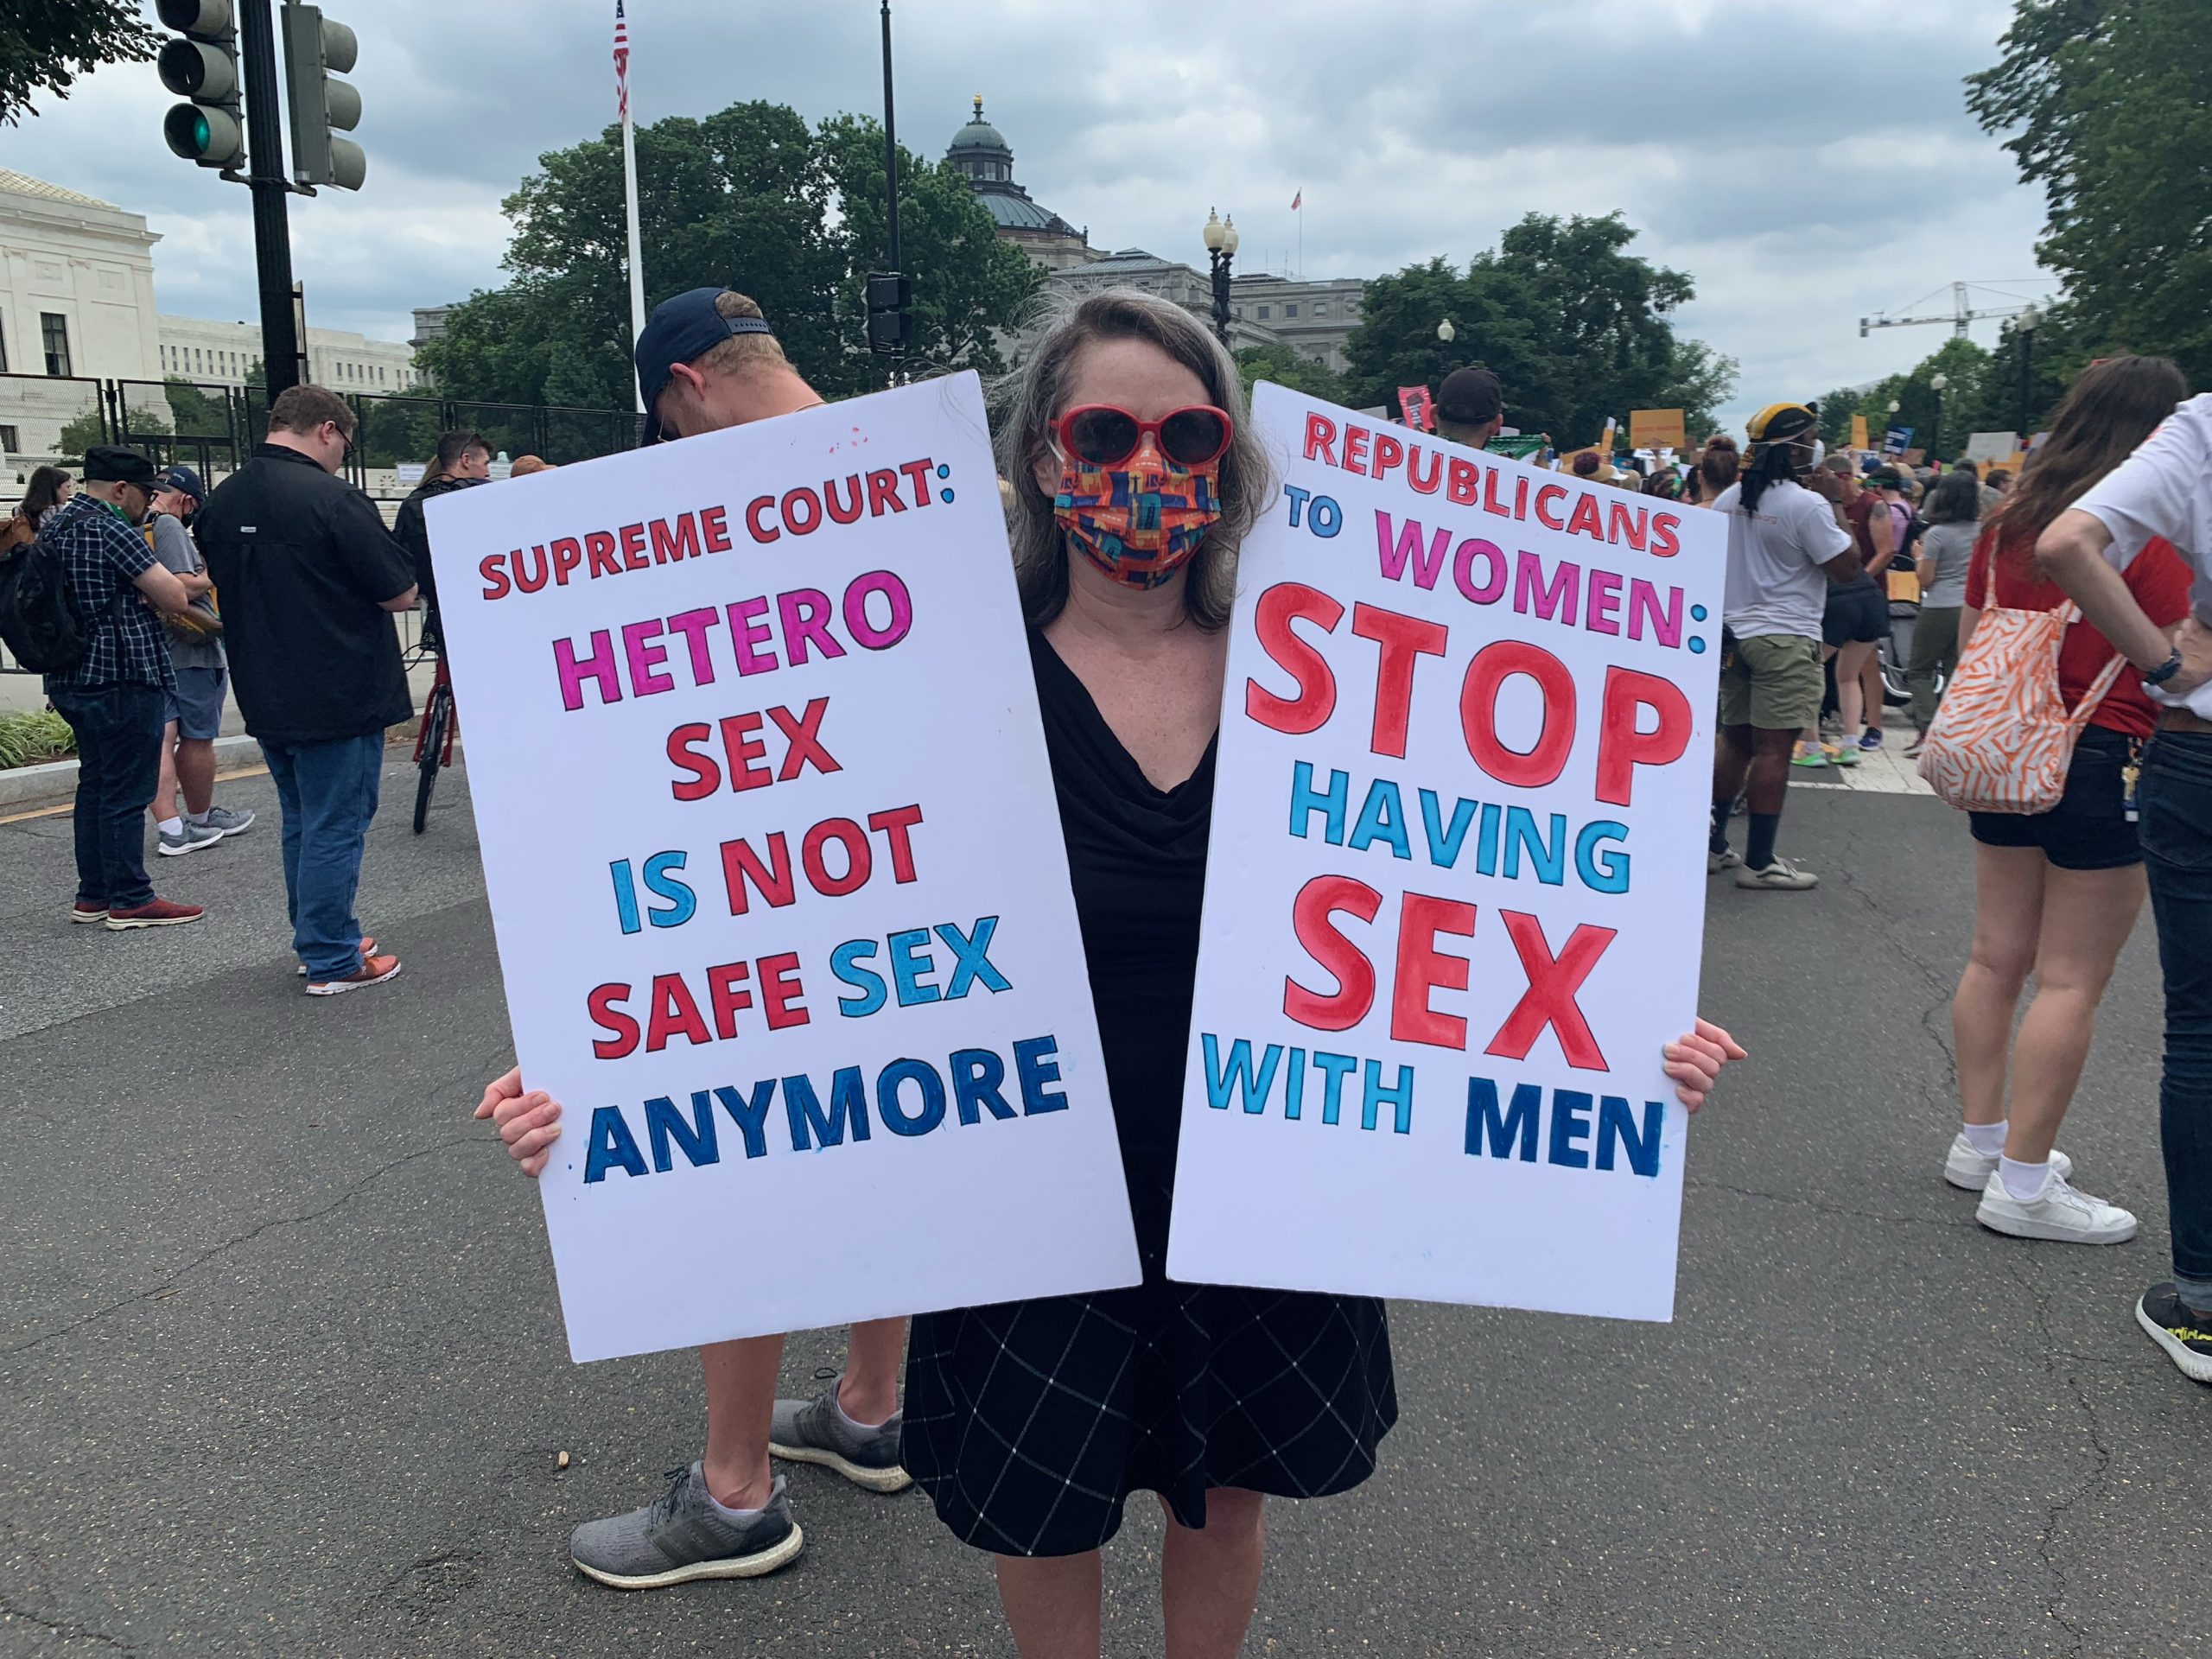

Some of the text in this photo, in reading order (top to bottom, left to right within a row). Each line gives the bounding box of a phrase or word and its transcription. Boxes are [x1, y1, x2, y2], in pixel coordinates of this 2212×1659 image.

[479, 457, 956, 601] SUPREME COURT:
[1303, 410, 1681, 558] REPUBLICANS
[552, 569, 912, 712] HETERO
[1284, 483, 1708, 655] TO WOMEN:
[666, 696, 843, 802] SEX
[1244, 582, 1693, 807] STOP
[609, 803, 924, 936] IS NOT
[1288, 760, 1631, 894] HAVING
[587, 915, 1014, 1060] SAFE SEX
[1282, 874, 1618, 1072] SEX
[583, 1034, 1070, 1185] ANYMORE
[1201, 1032, 1664, 1178] WITH MEN
